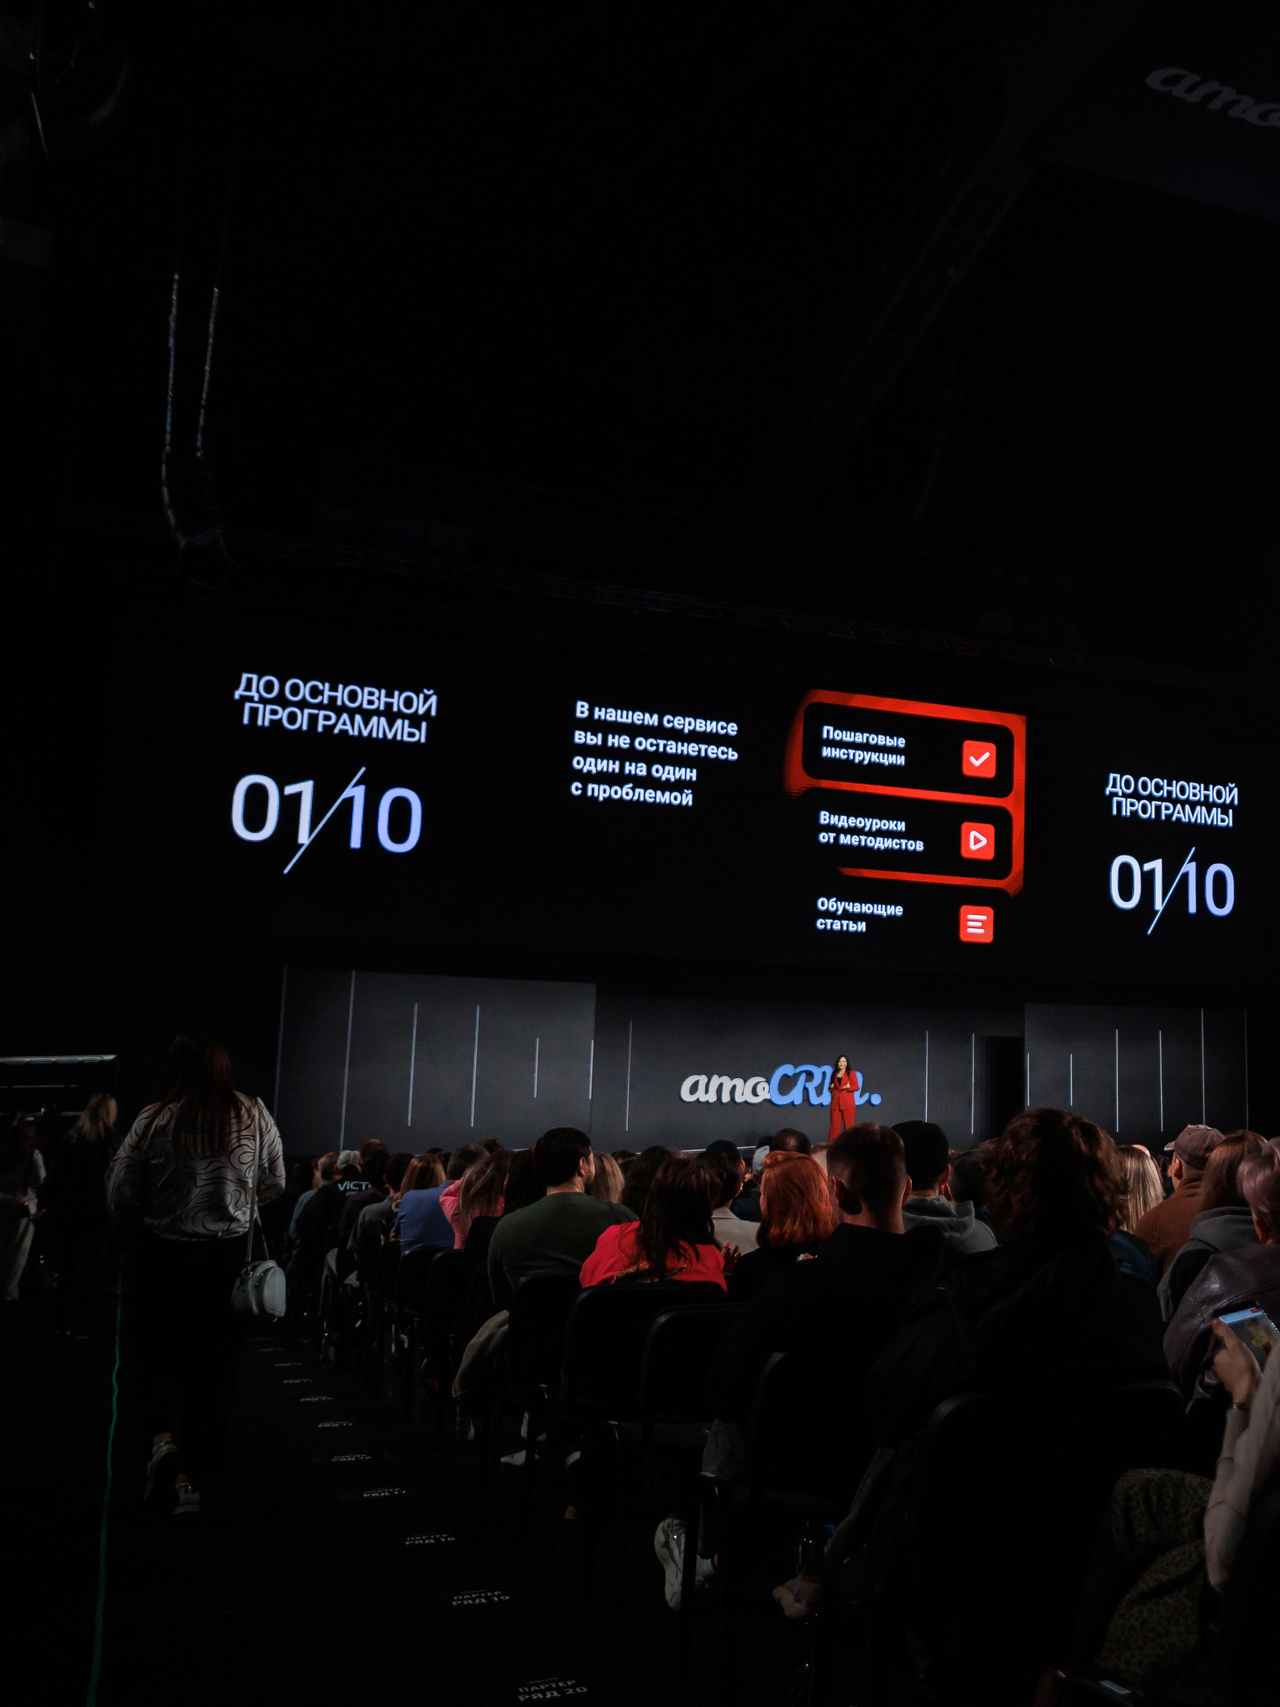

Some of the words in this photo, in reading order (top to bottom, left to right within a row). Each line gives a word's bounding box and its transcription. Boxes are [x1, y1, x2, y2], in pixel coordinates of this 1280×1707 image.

[234, 673, 279, 700] ДО
[284, 678, 437, 716] ОСНОВНОЙ
[243, 702, 427, 743] ПРОГРАММЫ
[576, 701, 589, 718] В
[593, 705, 659, 727] нашем
[663, 713, 738, 737] сервисе
[574, 730, 602, 746] вы
[607, 733, 630, 749] не
[634, 734, 738, 761] останетесь
[822, 726, 906, 748] Пошаговые
[572, 755, 620, 776] один
[624, 759, 647, 776] на
[651, 762, 697, 782] один
[822, 746, 906, 767] инструкции
[571, 782, 582, 795] с
[587, 780, 693, 806] проблемой
[1105, 773, 1135, 797] ДО
[1137, 777, 1239, 805] ОСНОВНОЙ
[819, 811, 906, 833] Видеоуроки
[1111, 797, 1234, 828] ПРОГРАММЫ
[818, 831, 836, 844] от
[839, 833, 924, 852] методистов
[817, 897, 904, 917] Обучающие
[816, 917, 866, 933] статьи
[337, 1180, 372, 1191] VICT
[563, 1686, 588, 1695] 20
